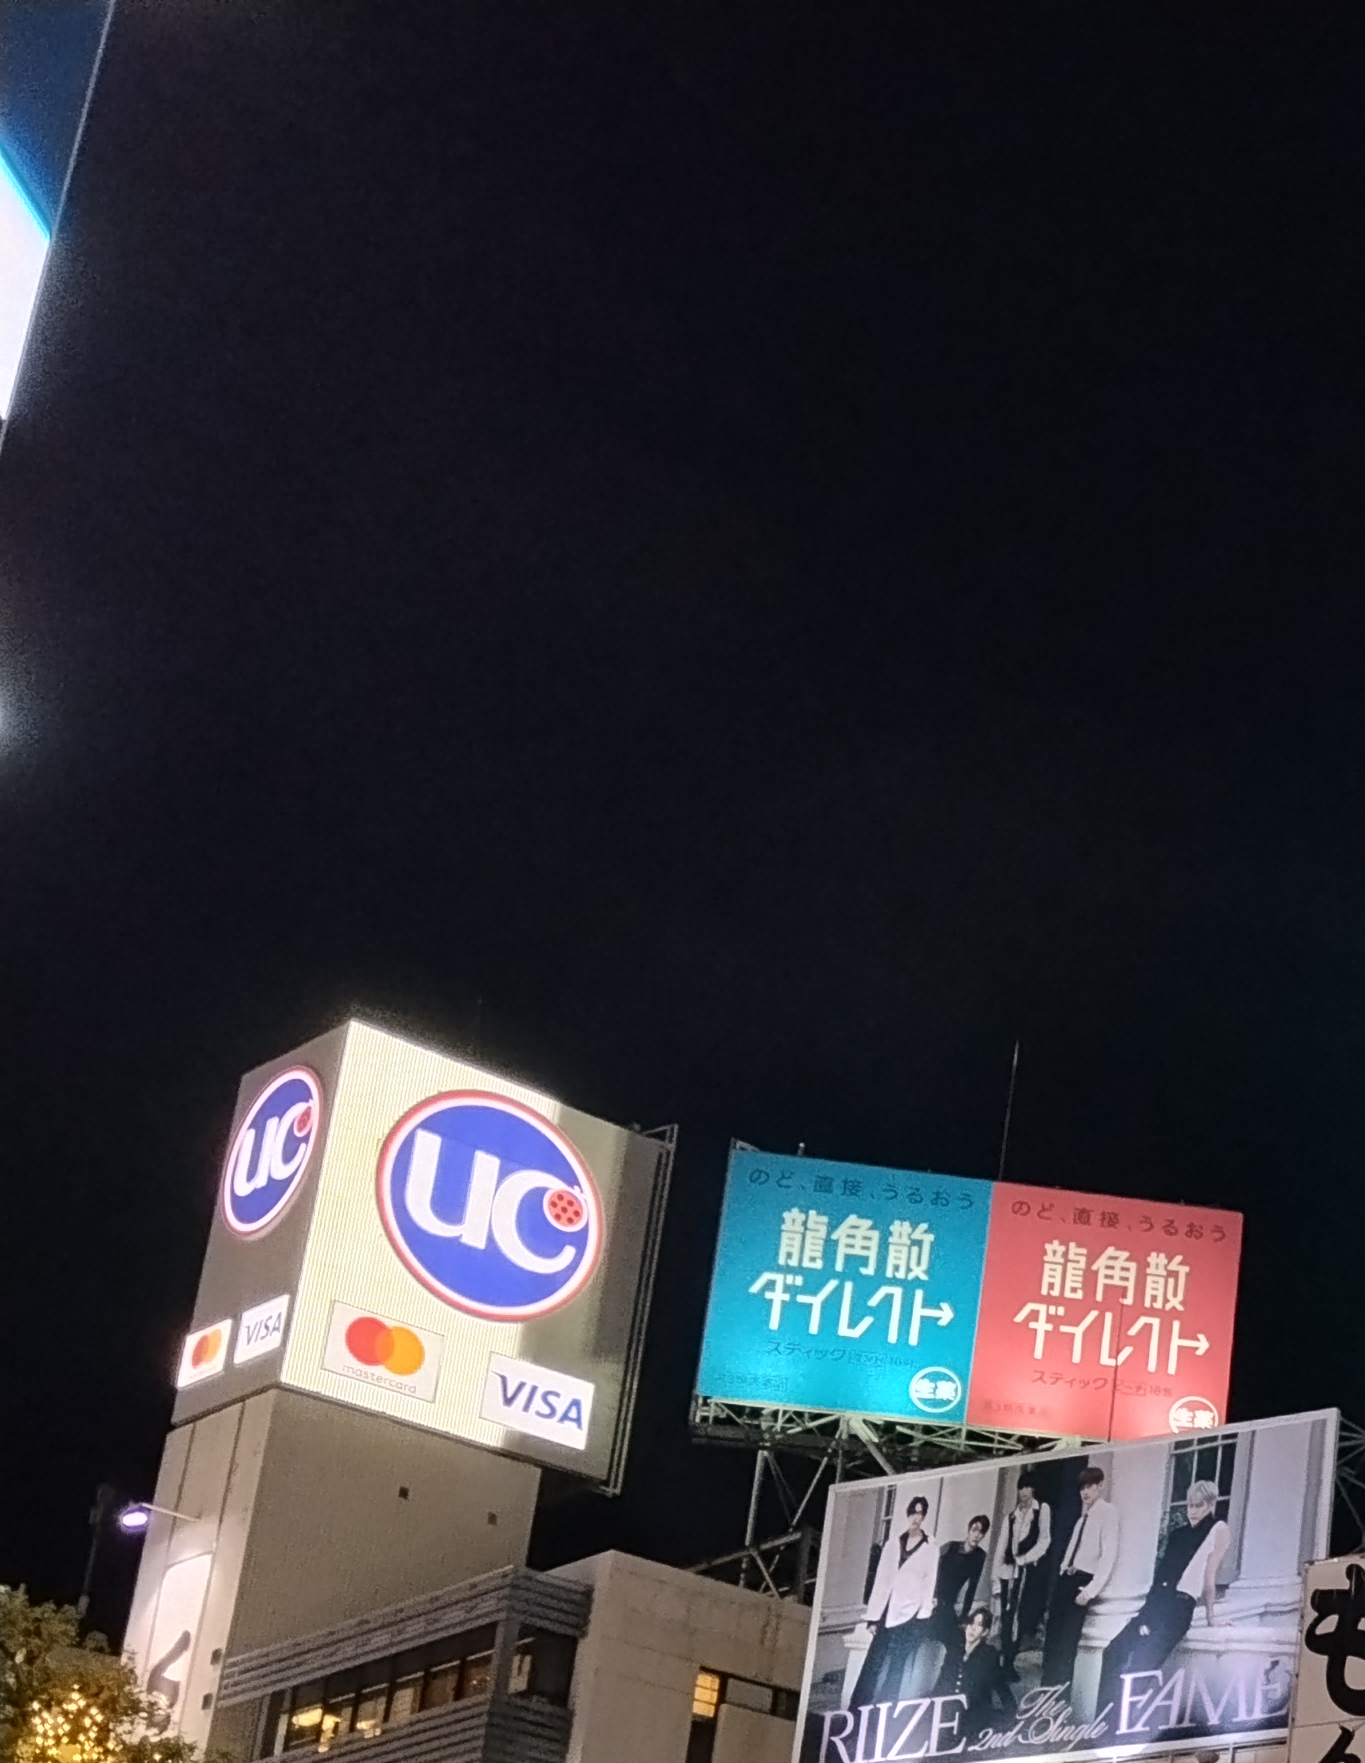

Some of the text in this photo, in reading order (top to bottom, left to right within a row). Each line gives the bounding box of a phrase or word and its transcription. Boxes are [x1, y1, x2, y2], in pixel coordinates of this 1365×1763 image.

[778, 1207, 935, 1282] 龍角散
[1041, 1240, 1190, 1312] 龍角散
[244, 1311, 282, 1347] VISA
[748, 1271, 954, 1347] ダイレクト
[1013, 1302, 1210, 1375] ダイレクト
[341, 1364, 417, 1394] mastercard
[491, 1369, 584, 1431] VISA
[968, 1702, 1114, 1752] 2nd Single
[1016, 1682, 1070, 1720] The
[1114, 1659, 1288, 1735] FAME
